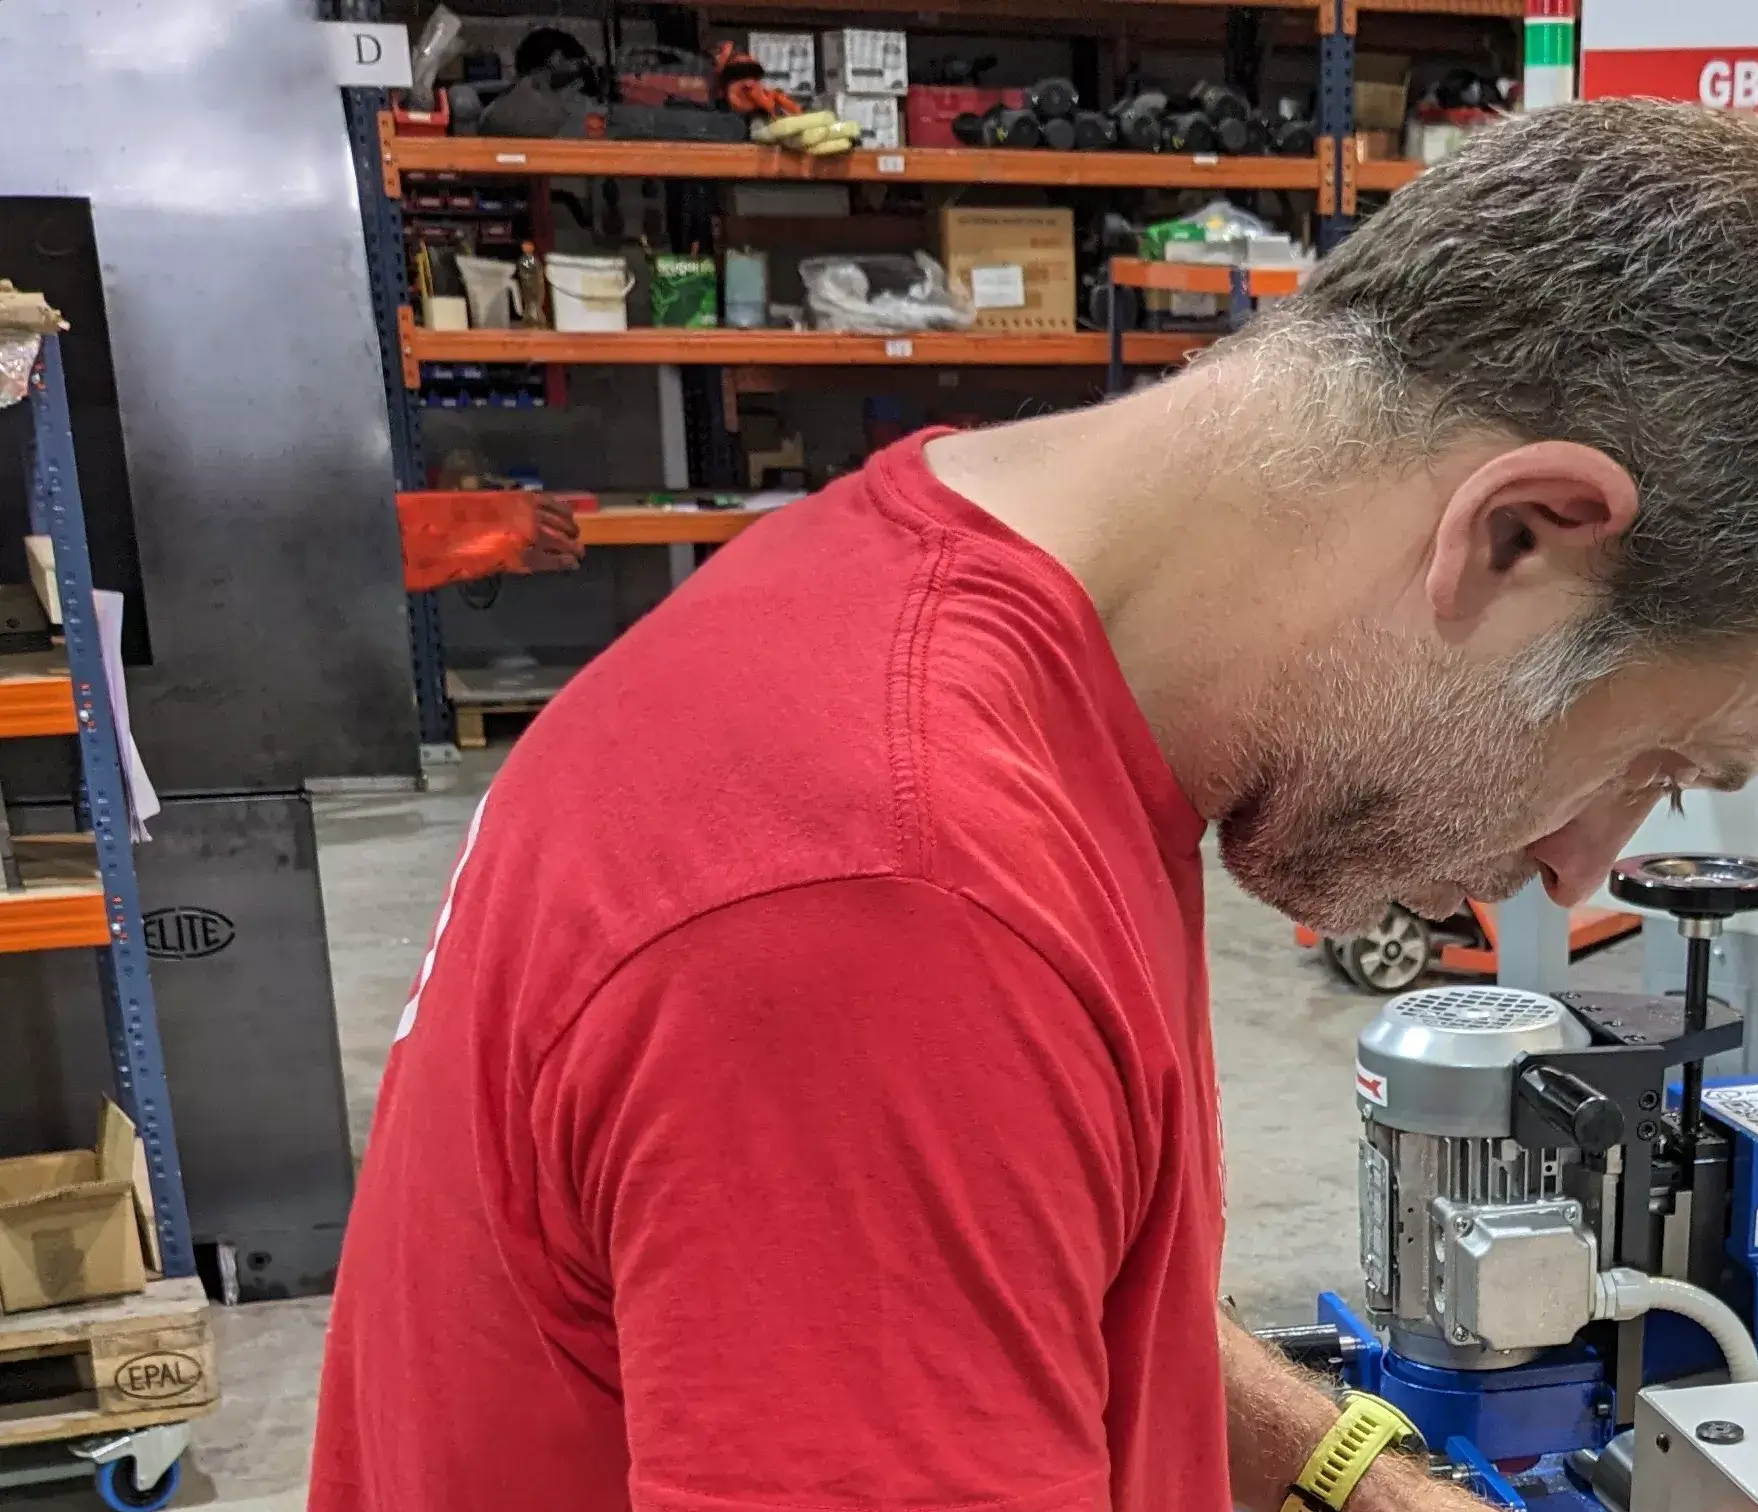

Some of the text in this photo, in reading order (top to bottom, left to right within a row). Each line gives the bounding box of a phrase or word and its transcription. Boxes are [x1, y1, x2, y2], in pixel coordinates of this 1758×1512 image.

[353, 32, 382, 66] D
[143, 914, 221, 952] ELITE
[128, 1361, 196, 1392] EPAL
